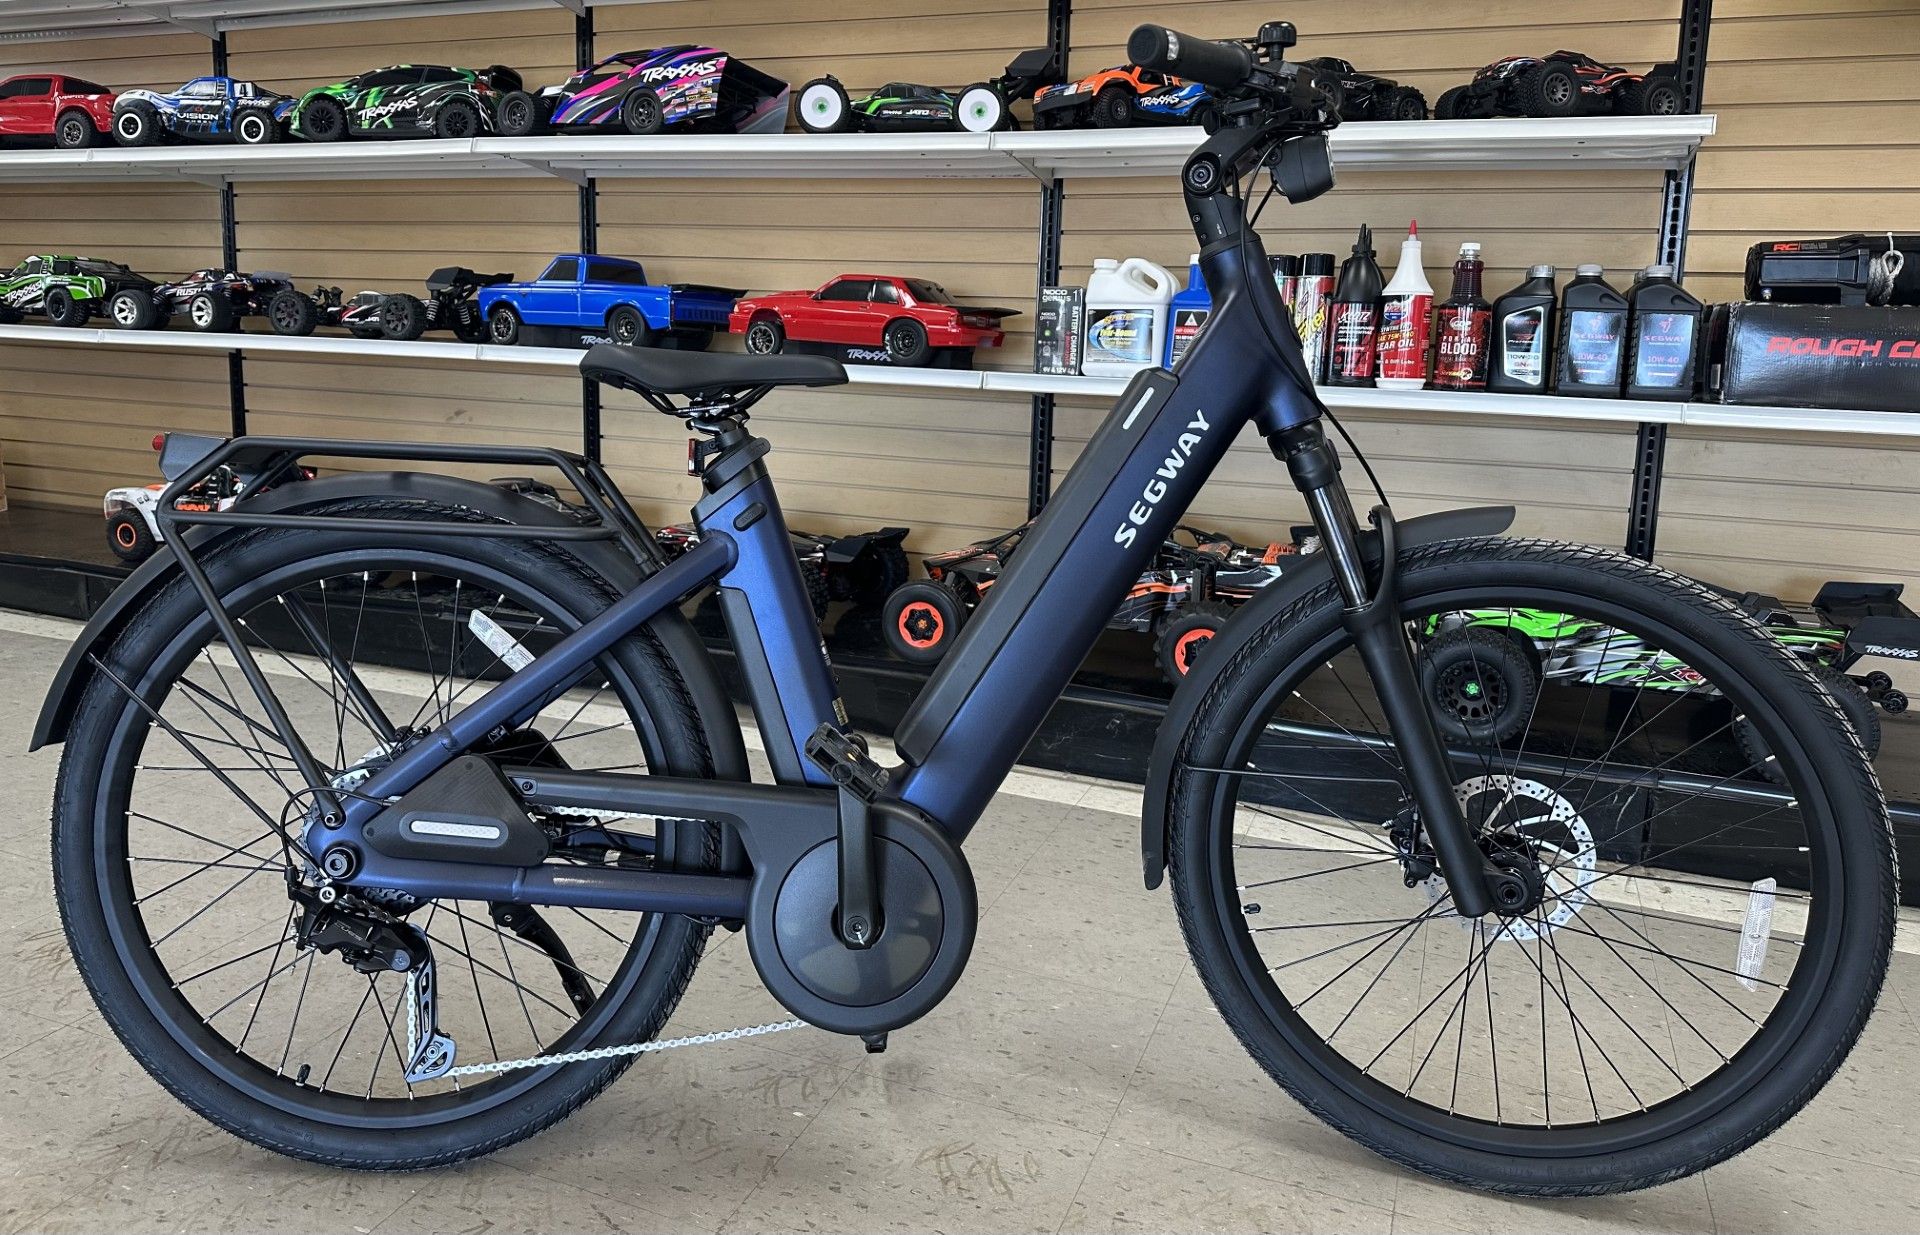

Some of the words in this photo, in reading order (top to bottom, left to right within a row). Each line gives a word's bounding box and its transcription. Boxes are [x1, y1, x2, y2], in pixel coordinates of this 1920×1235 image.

[641, 60, 718, 83] TRAXXAS
[1139, 94, 1180, 107] TRAXXAS
[358, 95, 418, 121] TRAXXAS
[177, 112, 219, 121] VISION
[1772, 243, 1800, 252] RC
[1071, 305, 1080, 335] BATTERY
[1397, 338, 1415, 349] OIL
[1644, 335, 1686, 343] SEGWAY
[1440, 342, 1477, 355] BLOOD
[1766, 336, 1883, 359] ROUGH
[1647, 355, 1680, 364] 10W-40
[1114, 409, 1210, 549] SEGWAY
[1864, 644, 1920, 659] TRAXXAS
